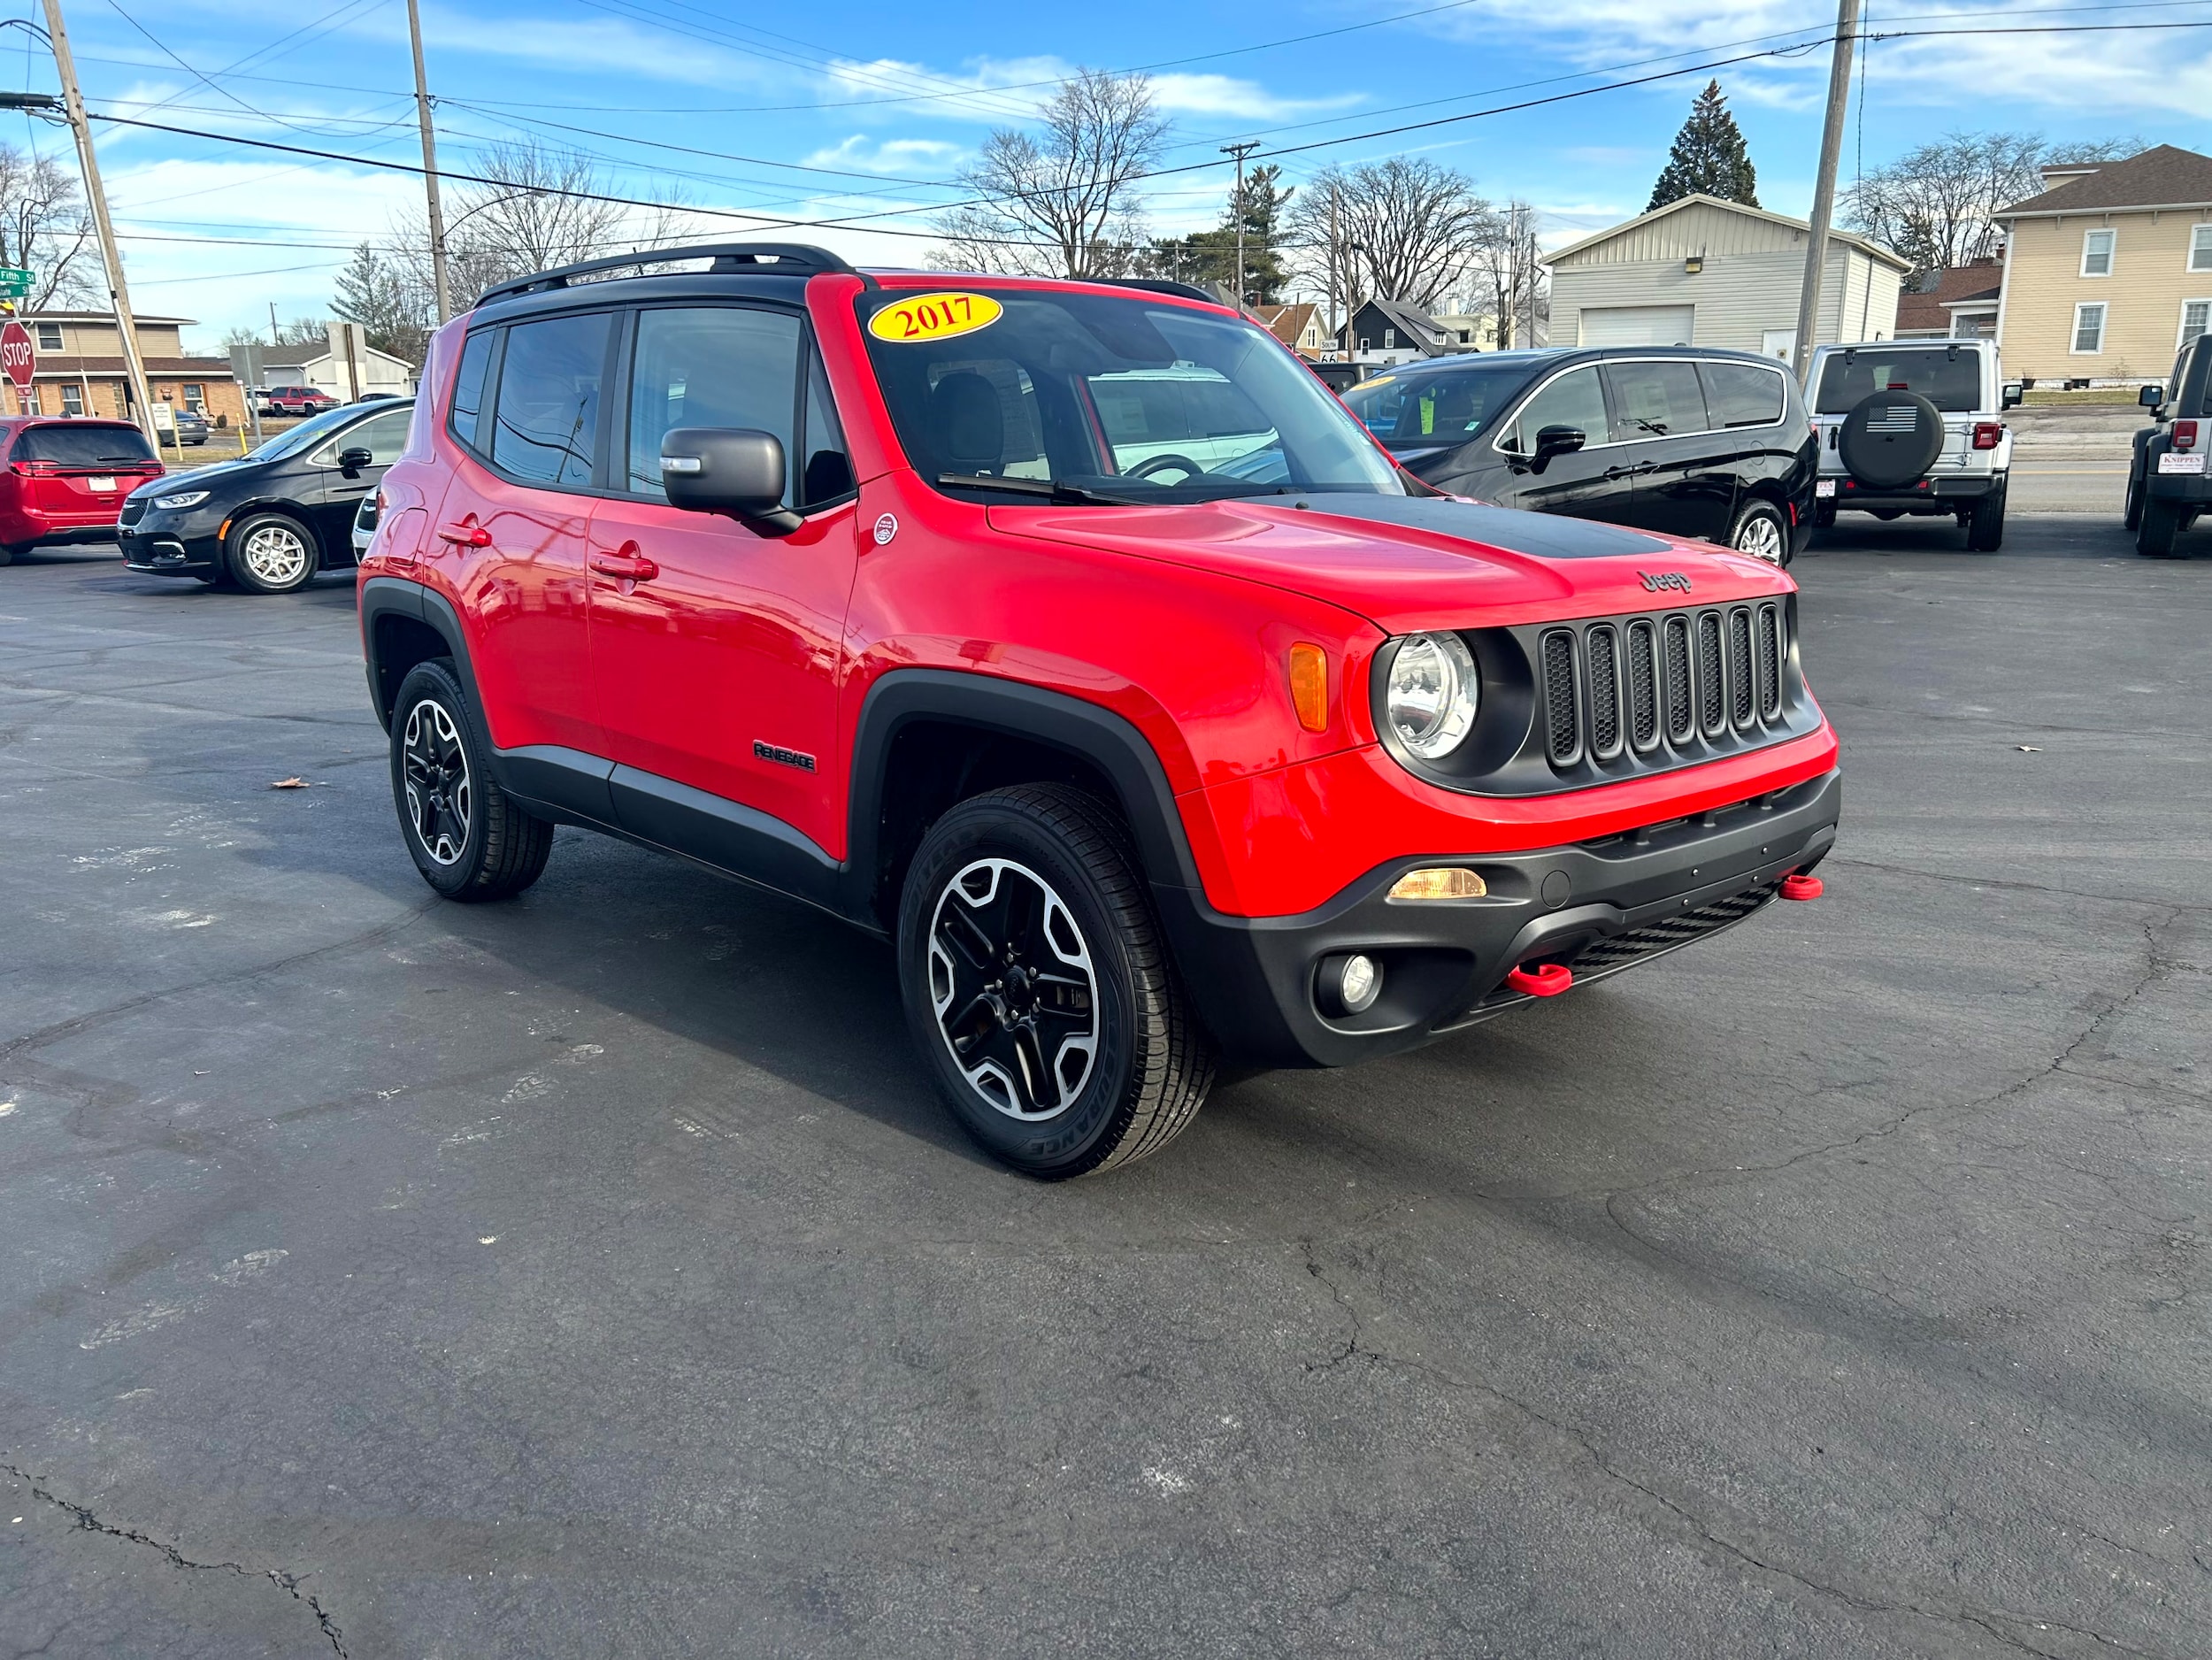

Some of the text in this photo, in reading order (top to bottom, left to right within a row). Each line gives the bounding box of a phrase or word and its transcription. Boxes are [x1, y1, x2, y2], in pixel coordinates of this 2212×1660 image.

[1, 271, 35, 282] Fifth St
[895, 296, 972, 338] 2017
[4, 342, 32, 367] STOP
[1636, 570, 1692, 594] Jeep
[753, 740, 817, 773] RENEGADE
